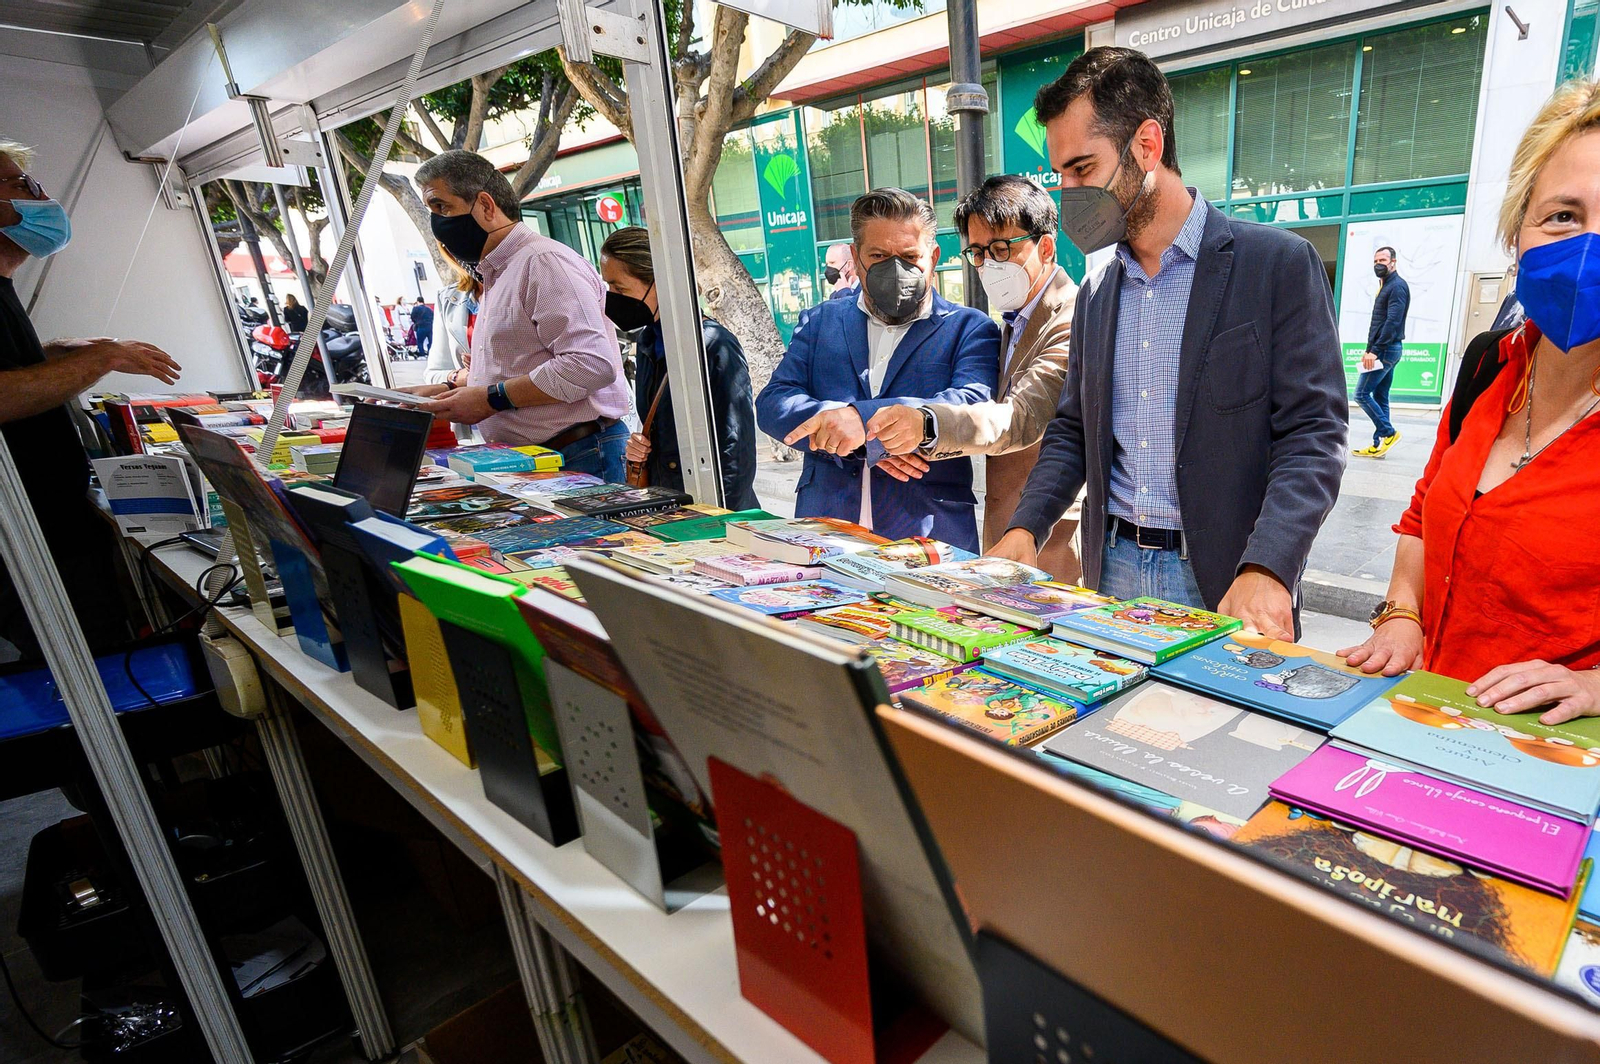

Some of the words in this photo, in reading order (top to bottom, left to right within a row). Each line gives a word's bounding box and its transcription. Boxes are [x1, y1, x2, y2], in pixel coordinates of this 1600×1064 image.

[1128, 24, 1181, 48] Centro
[1185, 7, 1246, 34] Unicaja
[1250, 1, 1272, 20] de
[1018, 165, 1063, 187] nicaj
[767, 203, 807, 227] Unicaja
[1402, 349, 1430, 357] UBISMO.
[757, 575, 790, 586] MARTINA
[1083, 729, 1138, 756] lluvia
[1427, 732, 1522, 764] Clementina
[1142, 750, 1165, 765] la
[1434, 746, 1496, 768] Arturo
[1166, 760, 1226, 785] veces
[1402, 778, 1443, 799] blanco
[1445, 789, 1486, 808] conejo
[1487, 803, 1542, 825] pequeño
[1542, 821, 1561, 836] El
[1313, 856, 1464, 928] mariposa
